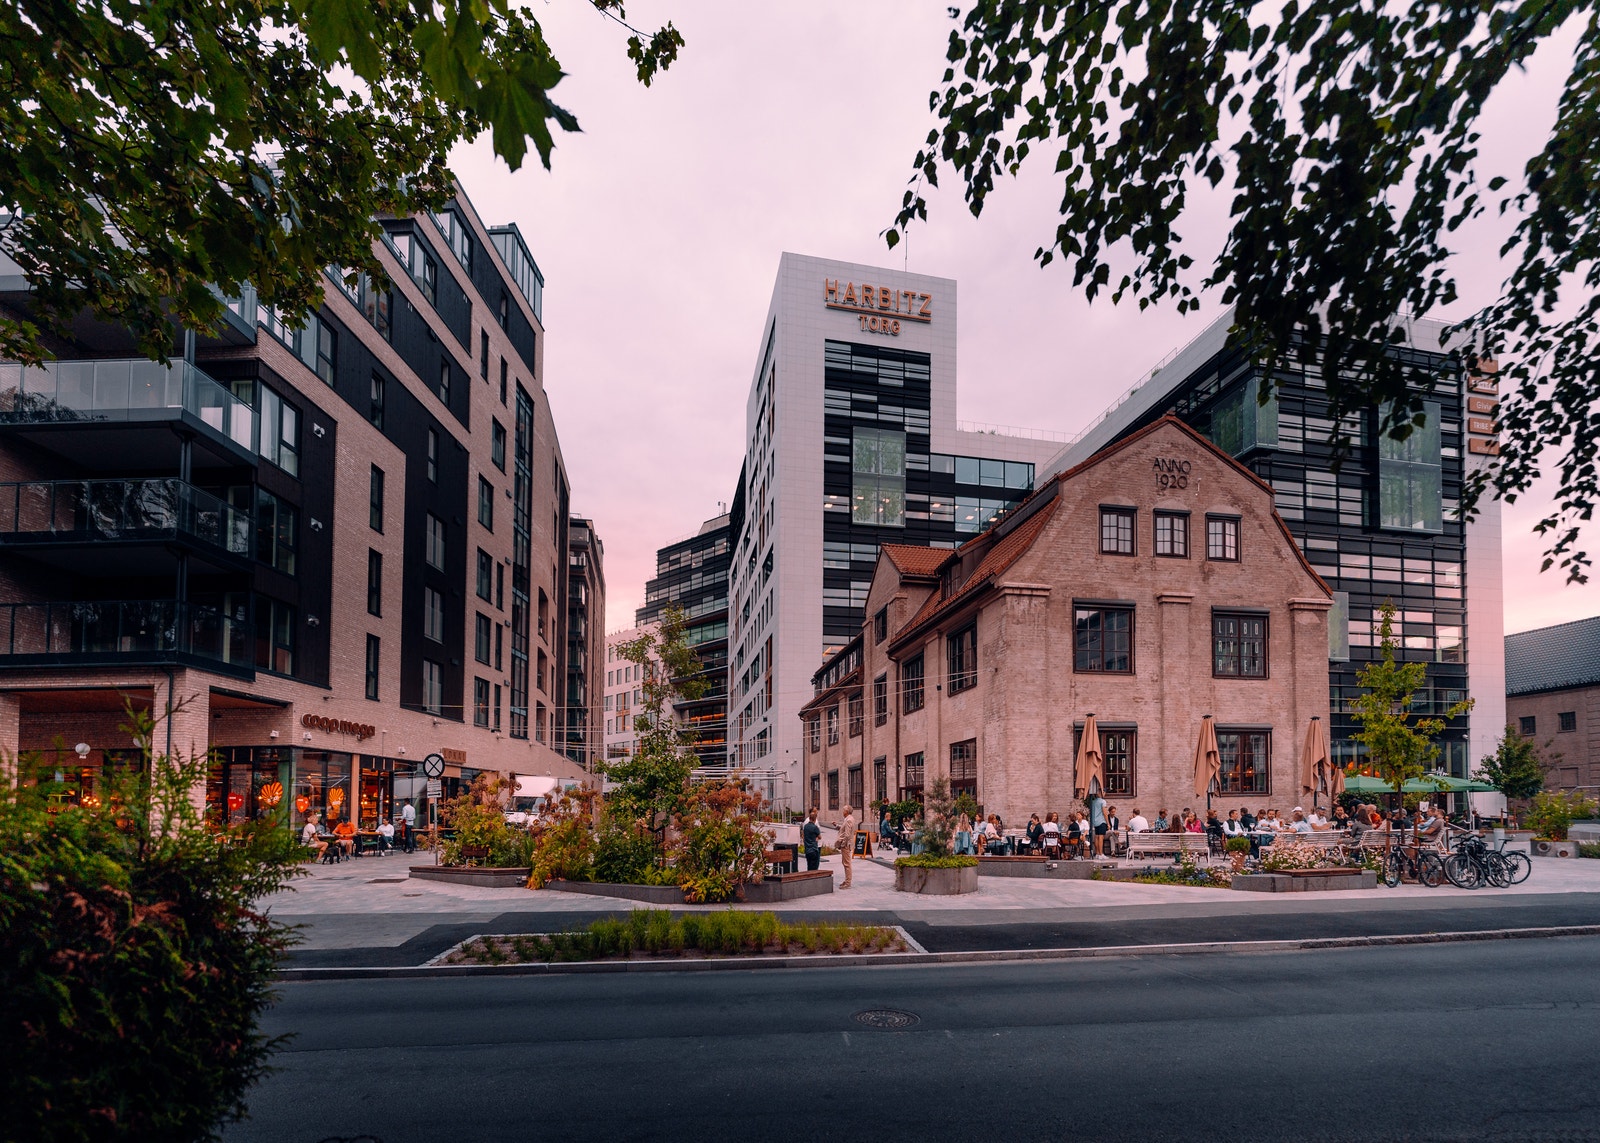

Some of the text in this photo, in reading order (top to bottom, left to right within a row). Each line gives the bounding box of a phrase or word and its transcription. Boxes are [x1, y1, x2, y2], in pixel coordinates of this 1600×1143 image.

[824, 278, 932, 316] HARBITZ
[859, 315, 901, 335] TORG
[1152, 457, 1191, 474] ANNO
[1155, 473, 1188, 490] 1920
[301, 713, 376, 740] coop mega
